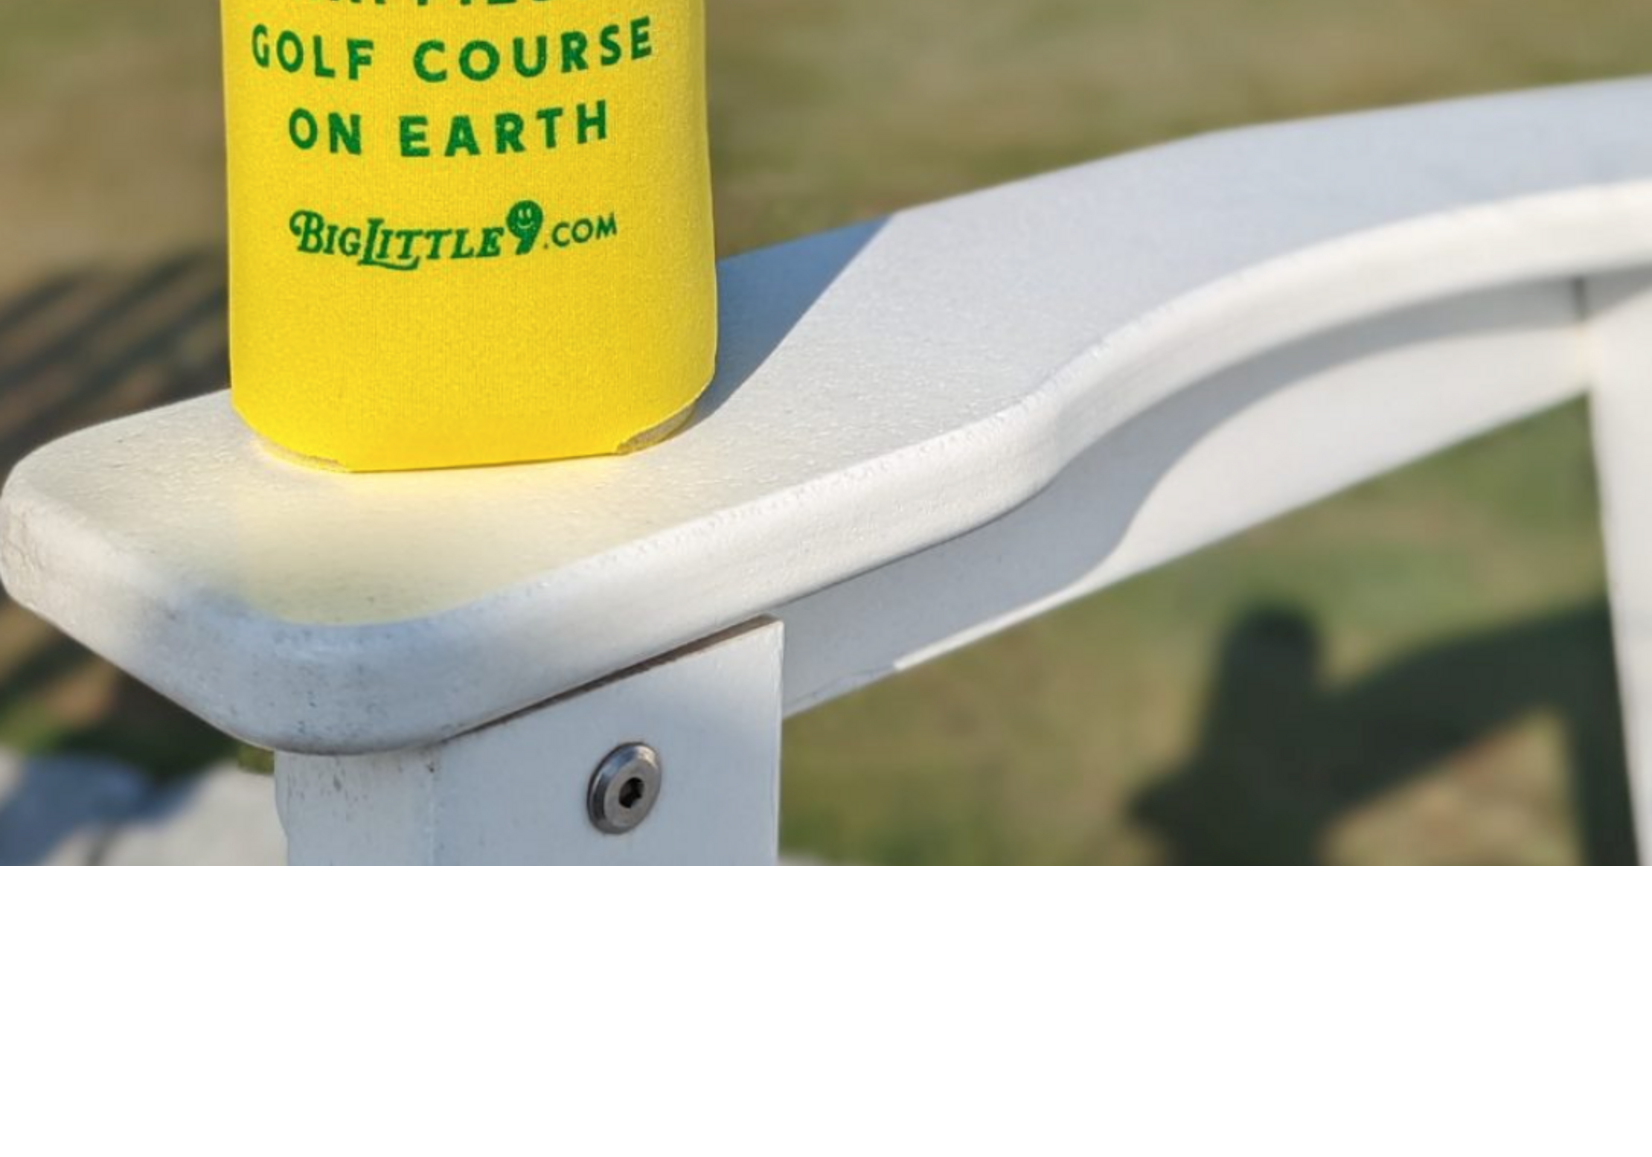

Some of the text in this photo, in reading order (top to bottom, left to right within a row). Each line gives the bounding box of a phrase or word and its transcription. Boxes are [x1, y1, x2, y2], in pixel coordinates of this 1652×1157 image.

[252, 16, 652, 83] GOLF COURSE
[288, 100, 608, 157] ON EARTH
